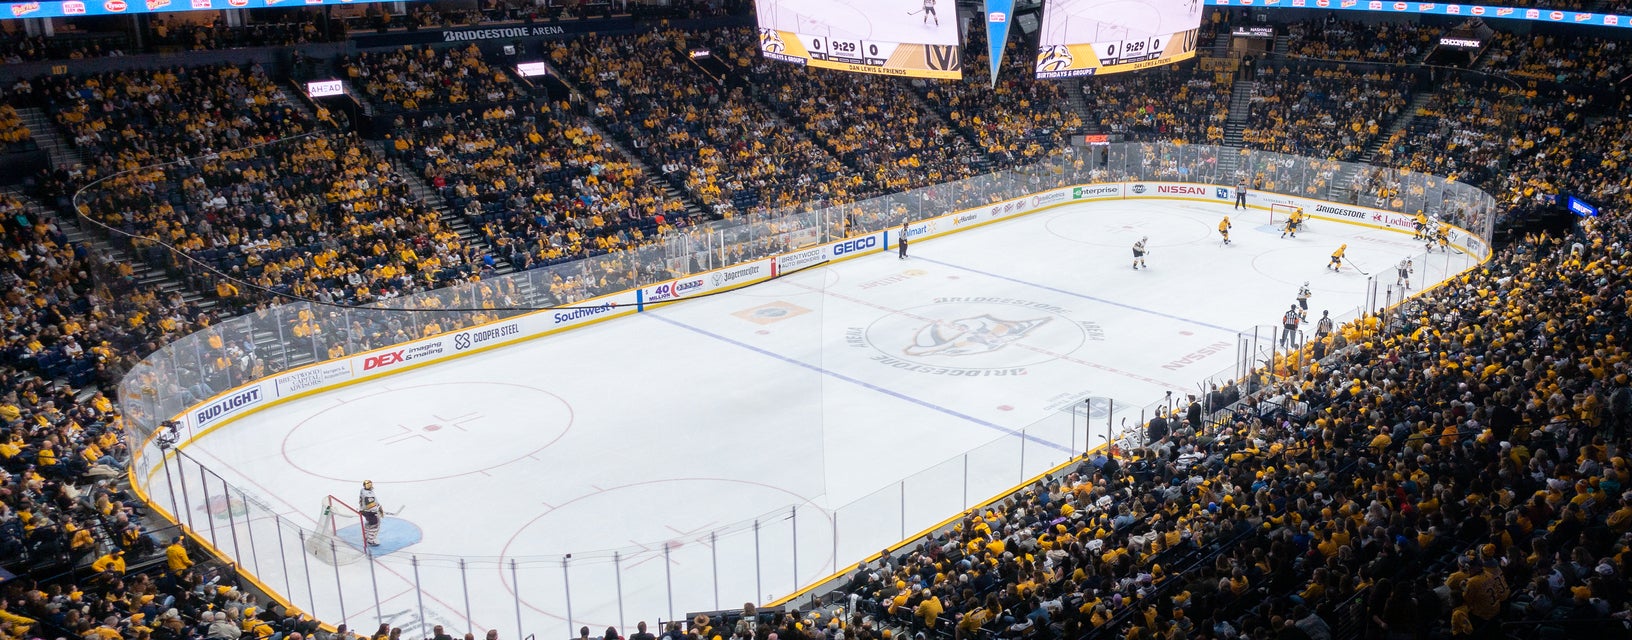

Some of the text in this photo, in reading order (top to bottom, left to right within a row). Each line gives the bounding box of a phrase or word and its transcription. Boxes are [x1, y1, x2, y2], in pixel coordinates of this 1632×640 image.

[443, 26, 564, 42] BRIDGESTONE ARENA
[813, 38, 821, 50] 0
[832, 41, 856, 52] 9:29
[869, 44, 879, 56] 0
[1107, 44, 1115, 56] 0
[1126, 41, 1145, 53] 9:29
[1153, 38, 1160, 50] 0
[882, 67, 907, 75] FRIENDS
[1037, 70, 1067, 79] BIRTHDAYS
[1073, 68, 1093, 76] GROUPS
[311, 84, 341, 94] AHEAD
[1085, 134, 1108, 143] DEX
[1075, 186, 1118, 195] enterprise
[1157, 185, 1206, 195] NISSAN
[1316, 204, 1366, 219] BRIDGESTONE
[898, 225, 927, 237] lmart
[833, 235, 876, 256] GEICO
[782, 249, 820, 263] BRENTWOOD
[782, 261, 796, 269] AUTO
[655, 284, 670, 295] 40
[649, 293, 671, 301] MILLION
[554, 302, 610, 324] Southwest
[473, 323, 520, 343] COOPER STEEL
[409, 342, 442, 353] imaging
[413, 348, 443, 359] mailing
[363, 349, 405, 371] DEX
[1160, 341, 1232, 371] NISSAN
[871, 354, 1028, 377] BRIDGESTONE
[279, 369, 320, 384] BRENTWOOD
[197, 389, 259, 424] BUD LIGHT
